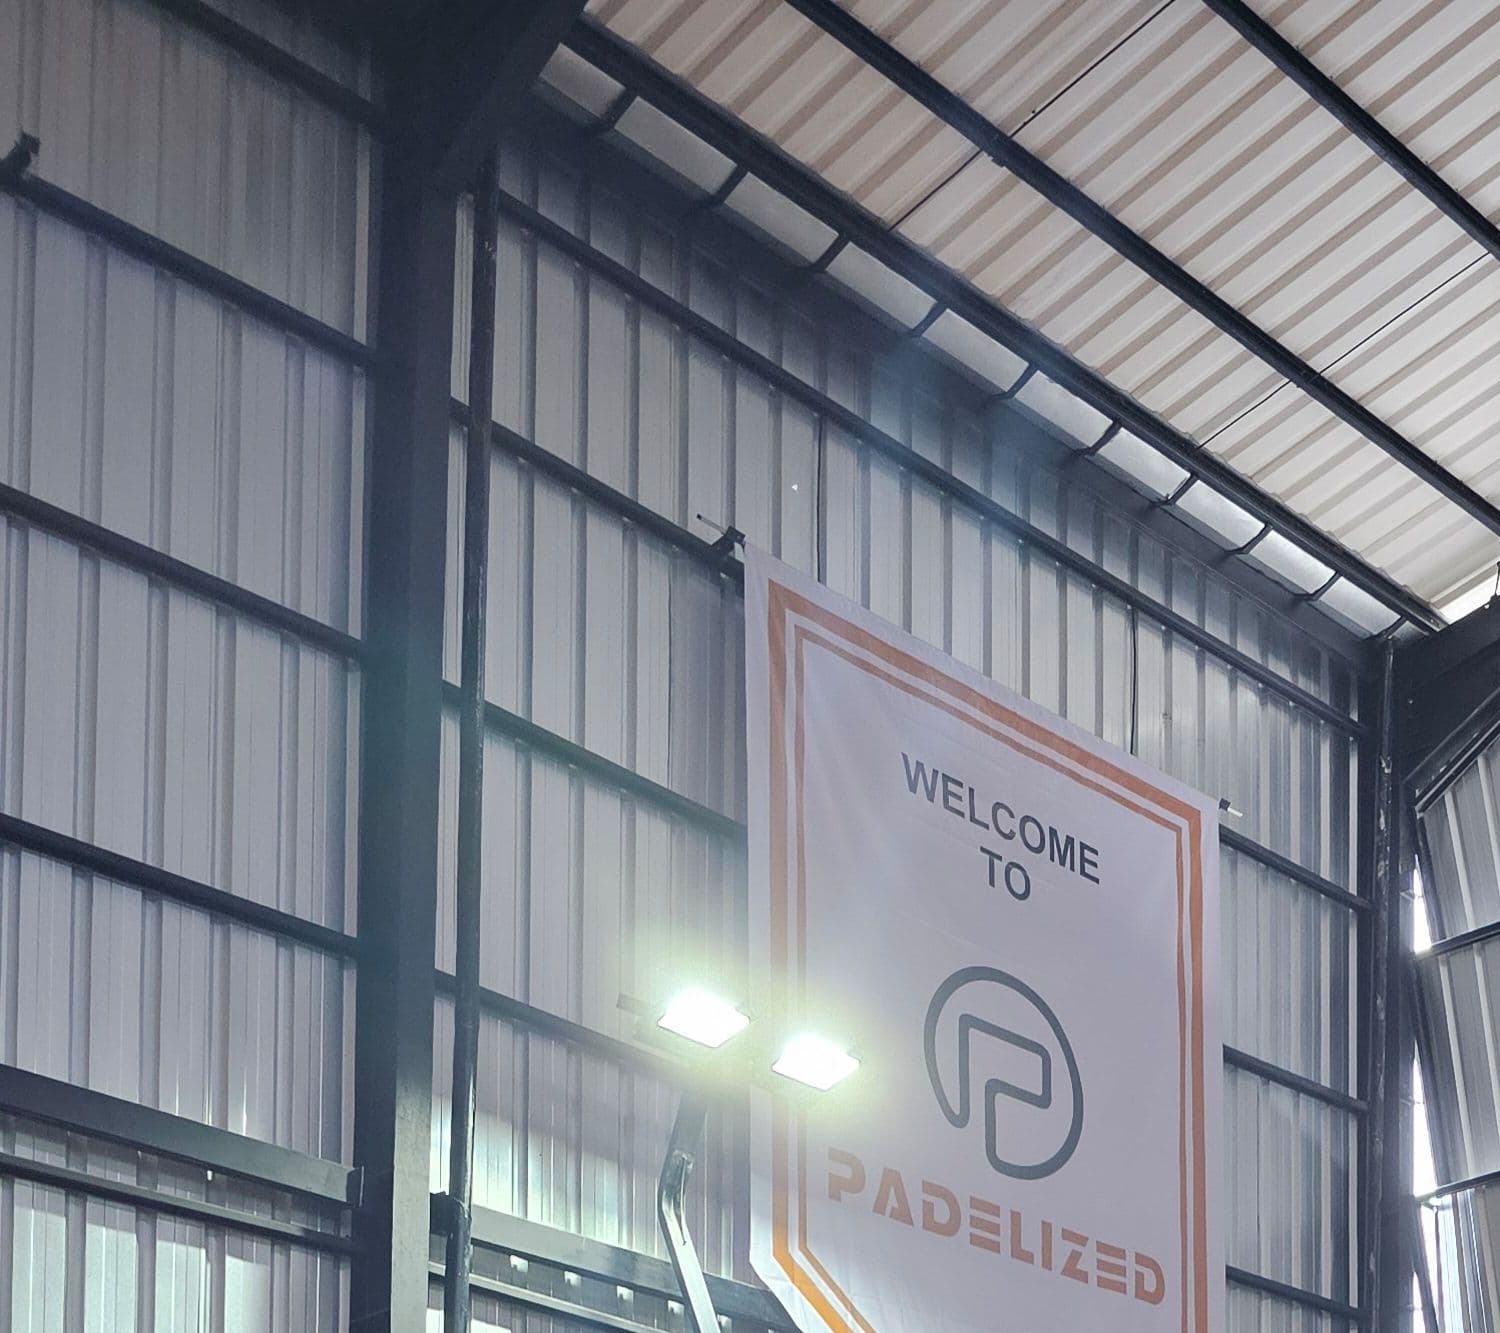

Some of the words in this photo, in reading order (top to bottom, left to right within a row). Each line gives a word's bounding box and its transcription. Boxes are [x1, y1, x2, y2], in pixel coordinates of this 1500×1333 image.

[901, 752, 1101, 885] WELCOME
[981, 847, 1032, 902] TO
[827, 1147, 1165, 1306] PADELIZED
